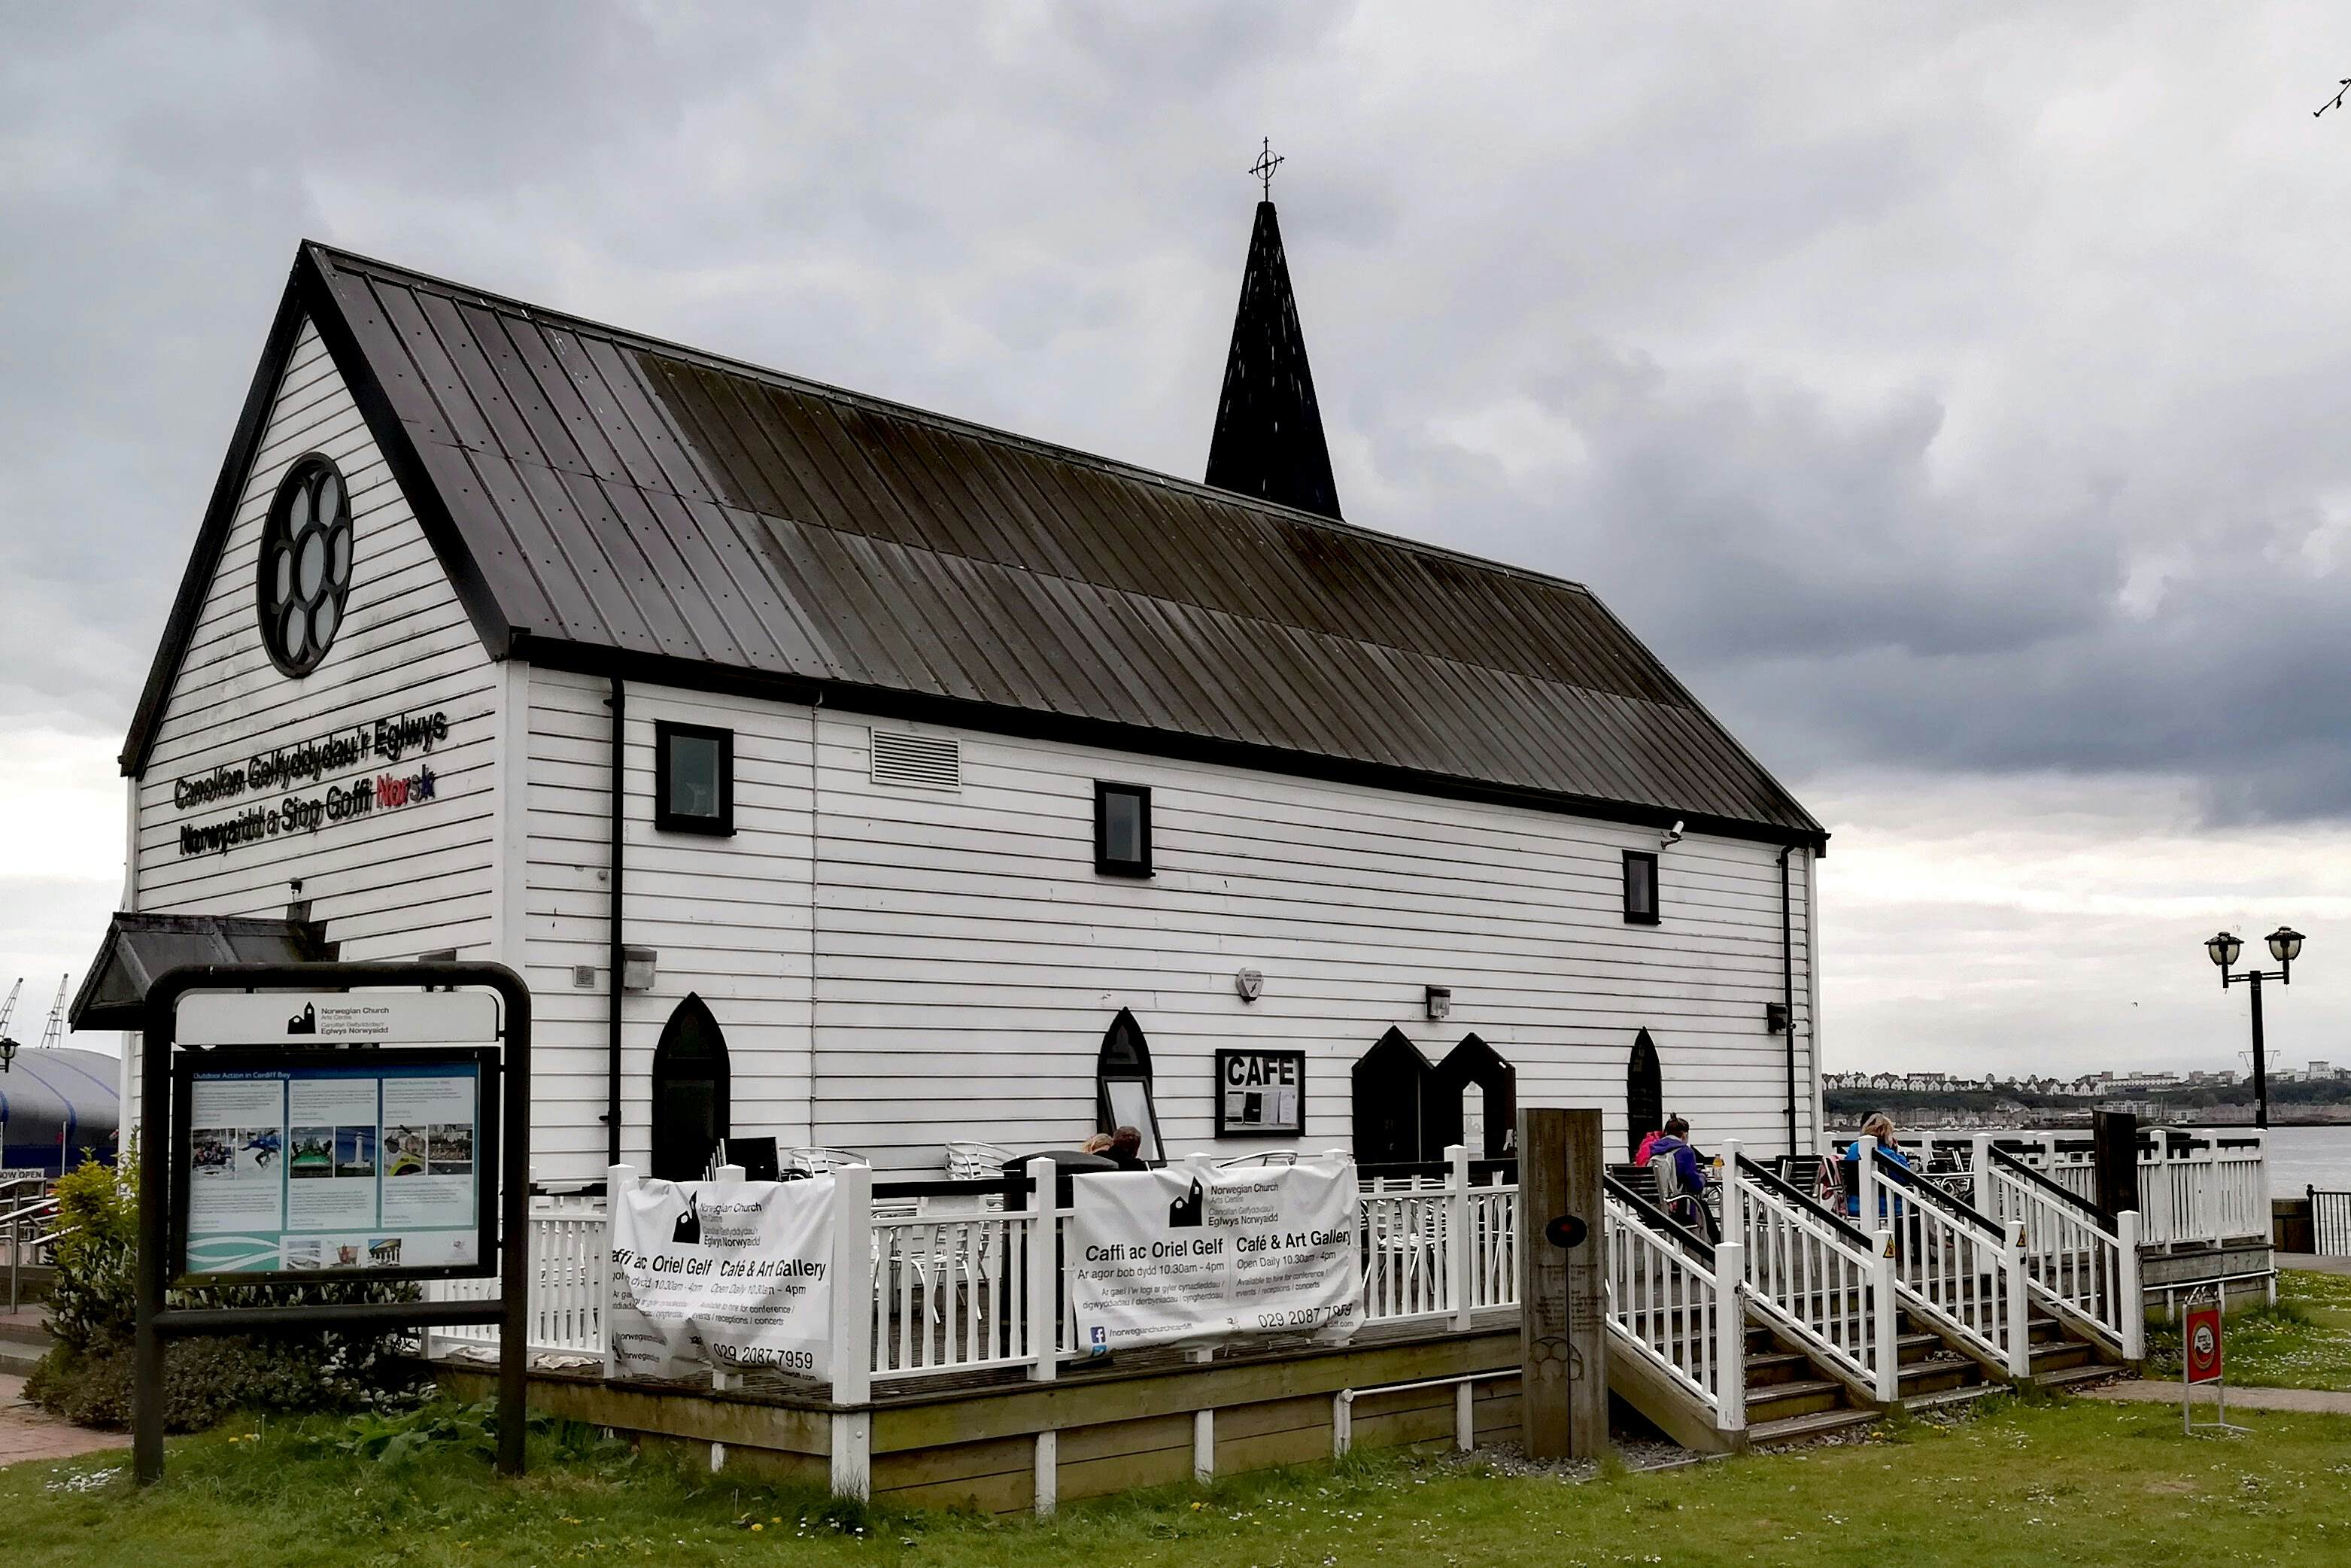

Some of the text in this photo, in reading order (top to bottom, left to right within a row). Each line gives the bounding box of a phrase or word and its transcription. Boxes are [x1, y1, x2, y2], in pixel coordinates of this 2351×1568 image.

[175, 766, 245, 810] Canolfan
[374, 711, 448, 761] Eglwys
[180, 764, 436, 856] Norwyaidd a Siop Goffi Norsk
[1228, 1056, 1294, 1086] CAFE
[1211, 1183, 1278, 1196] Norwegian Church
[734, 1202, 762, 1212] Church
[1208, 1213, 1278, 1227] Eglwys Norwyaidd
[1086, 1238, 1223, 1261] Caffi ac Oriel Gelf
[1237, 1229, 1351, 1252] Café & Art Gallery
[634, 1257, 647, 1269] ac
[653, 1255, 684, 1273] Oriel
[687, 1258, 712, 1275] Gelf
[721, 1259, 826, 1281] Café & Art Gallery
[1237, 1259, 1258, 1271] Open
[1260, 1257, 1280, 1268] Daily
[1283, 1254, 1314, 1265] 10.30am
[1320, 1251, 1336, 1262] 4pm
[1077, 1269, 1089, 1279] Ar
[1092, 1268, 1115, 1281] agor
[1117, 1266, 1135, 1278] bob
[1137, 1266, 1157, 1278] dydd
[1159, 1263, 1198, 1275] 10.30am
[1205, 1262, 1224, 1274] 4pm
[1236, 1278, 1265, 1287] Available
[1292, 1270, 1324, 1281] conference
[786, 1284, 806, 1296] 4pm
[1110, 1286, 1126, 1296] gael
[1140, 1287, 1152, 1296] logi
[1235, 1288, 1256, 1298] events
[1295, 1281, 1320, 1290] concerts
[749, 1305, 791, 1314] conference
[1258, 1313, 1284, 1328] 029
[1289, 1308, 1320, 1325] 2087
[714, 1344, 813, 1369] 029 2087 7959
